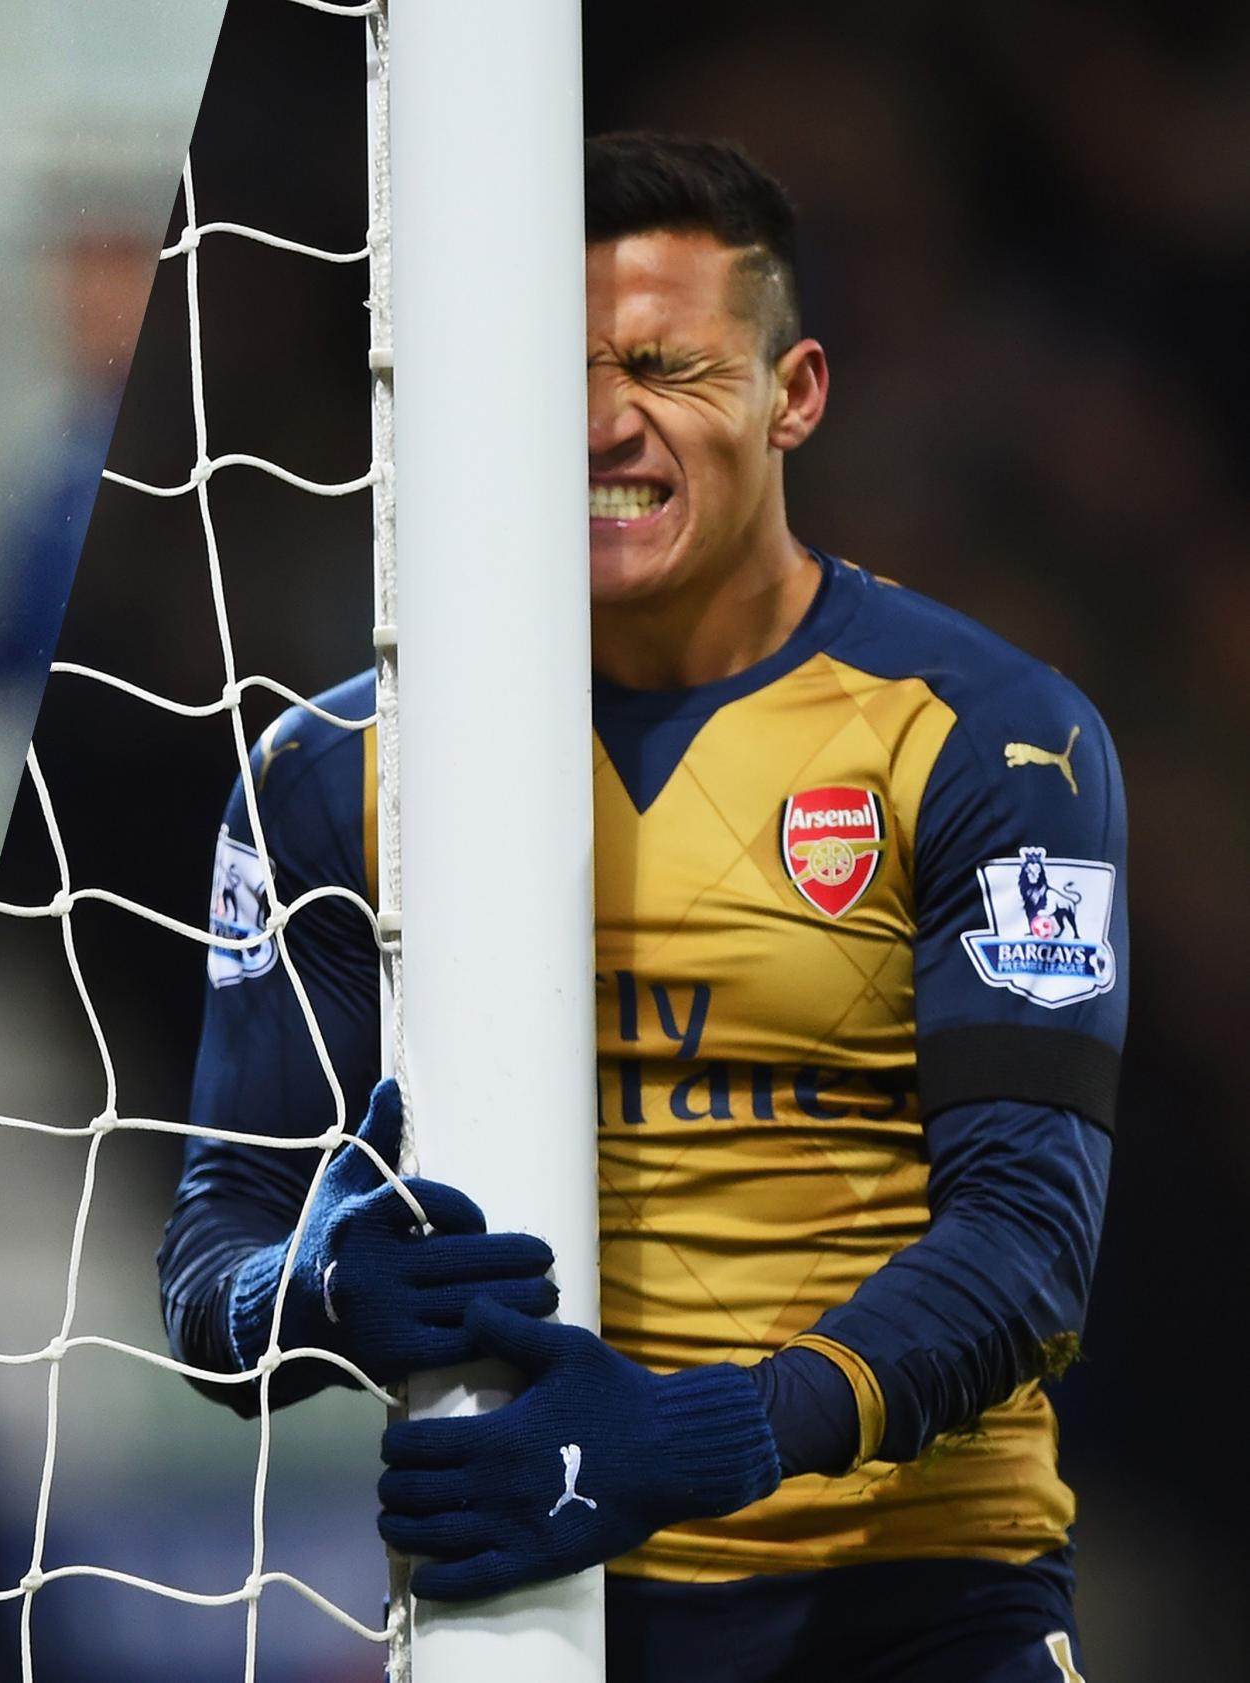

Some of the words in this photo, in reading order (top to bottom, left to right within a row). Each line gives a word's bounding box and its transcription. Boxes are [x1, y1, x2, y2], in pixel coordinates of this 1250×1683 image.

[790, 804, 871, 831] Arsenal
[998, 943, 1086, 964] BARCLAYS
[597, 969, 711, 1060] ly
